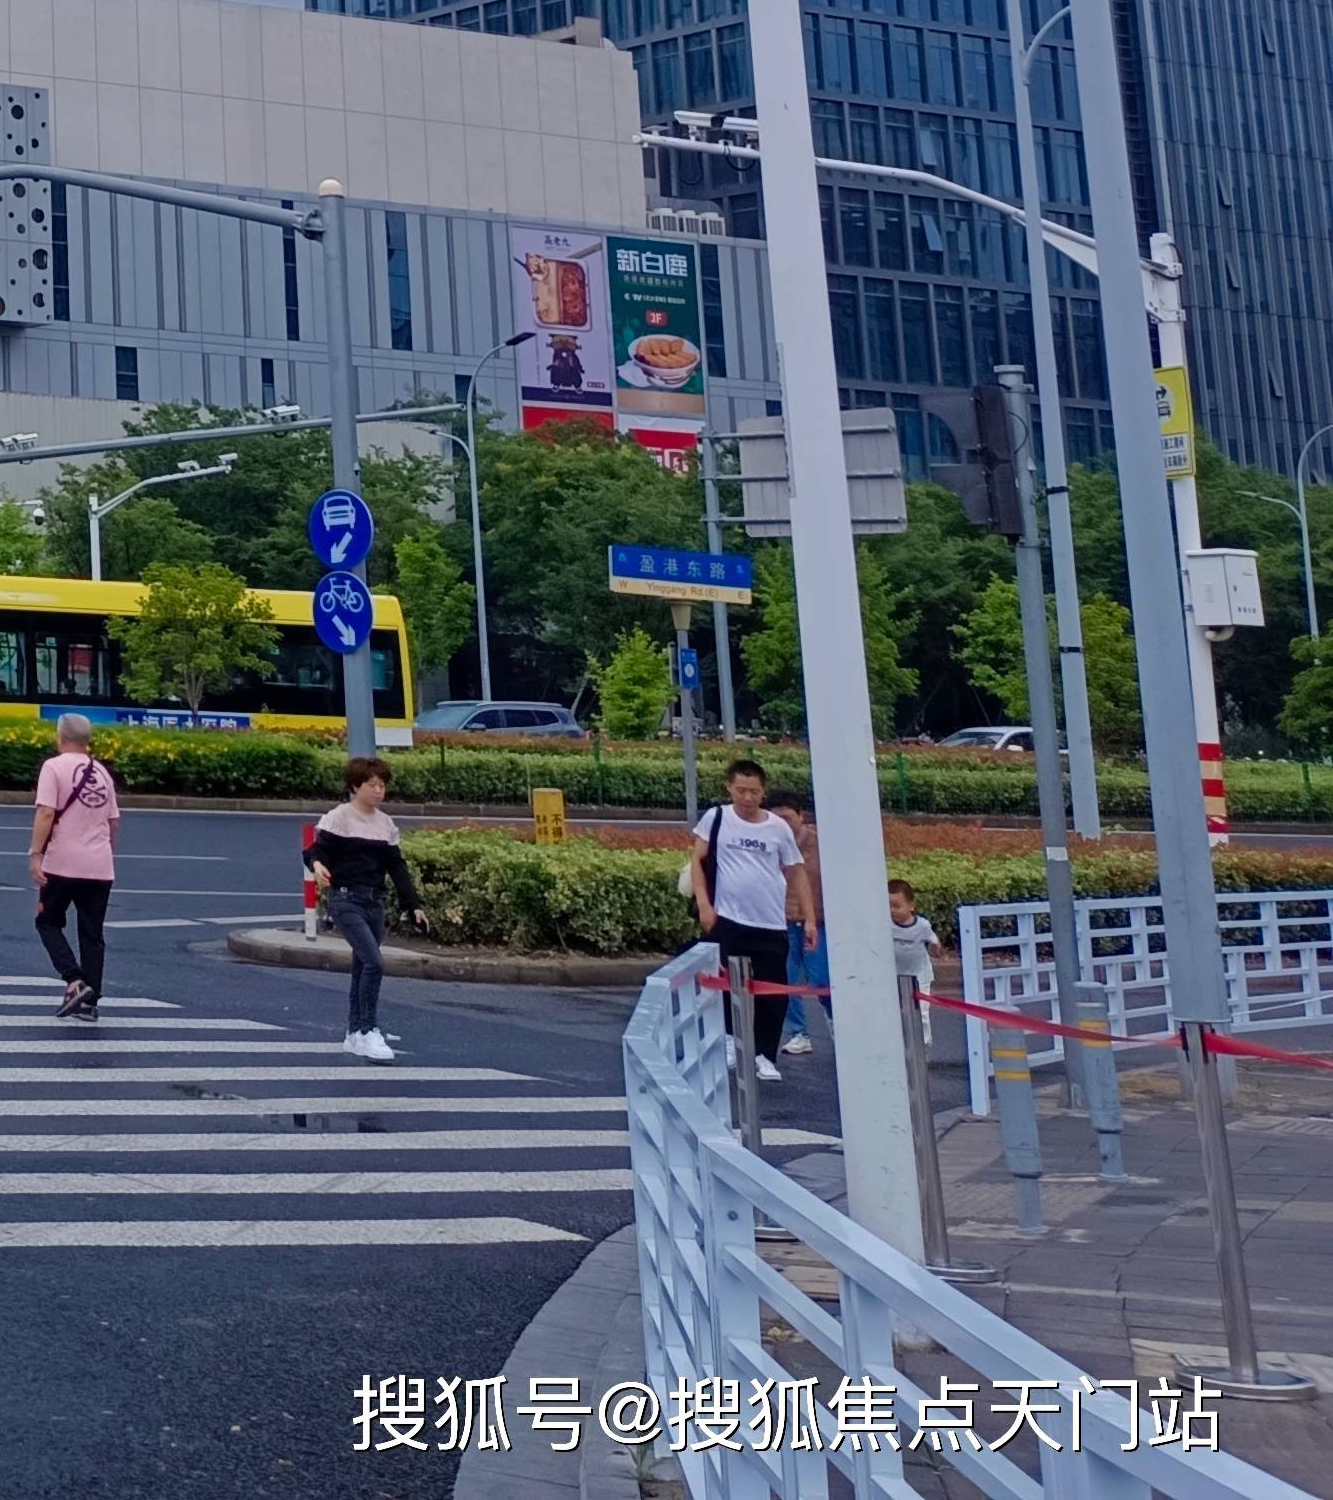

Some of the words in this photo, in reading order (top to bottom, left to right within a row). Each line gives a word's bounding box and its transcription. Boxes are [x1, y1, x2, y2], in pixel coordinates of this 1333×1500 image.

[615, 248, 689, 278] 新白鹿
[639, 553, 727, 581] 盈港东路
[618, 579, 629, 589] W
[645, 581, 687, 597] Yinggang
